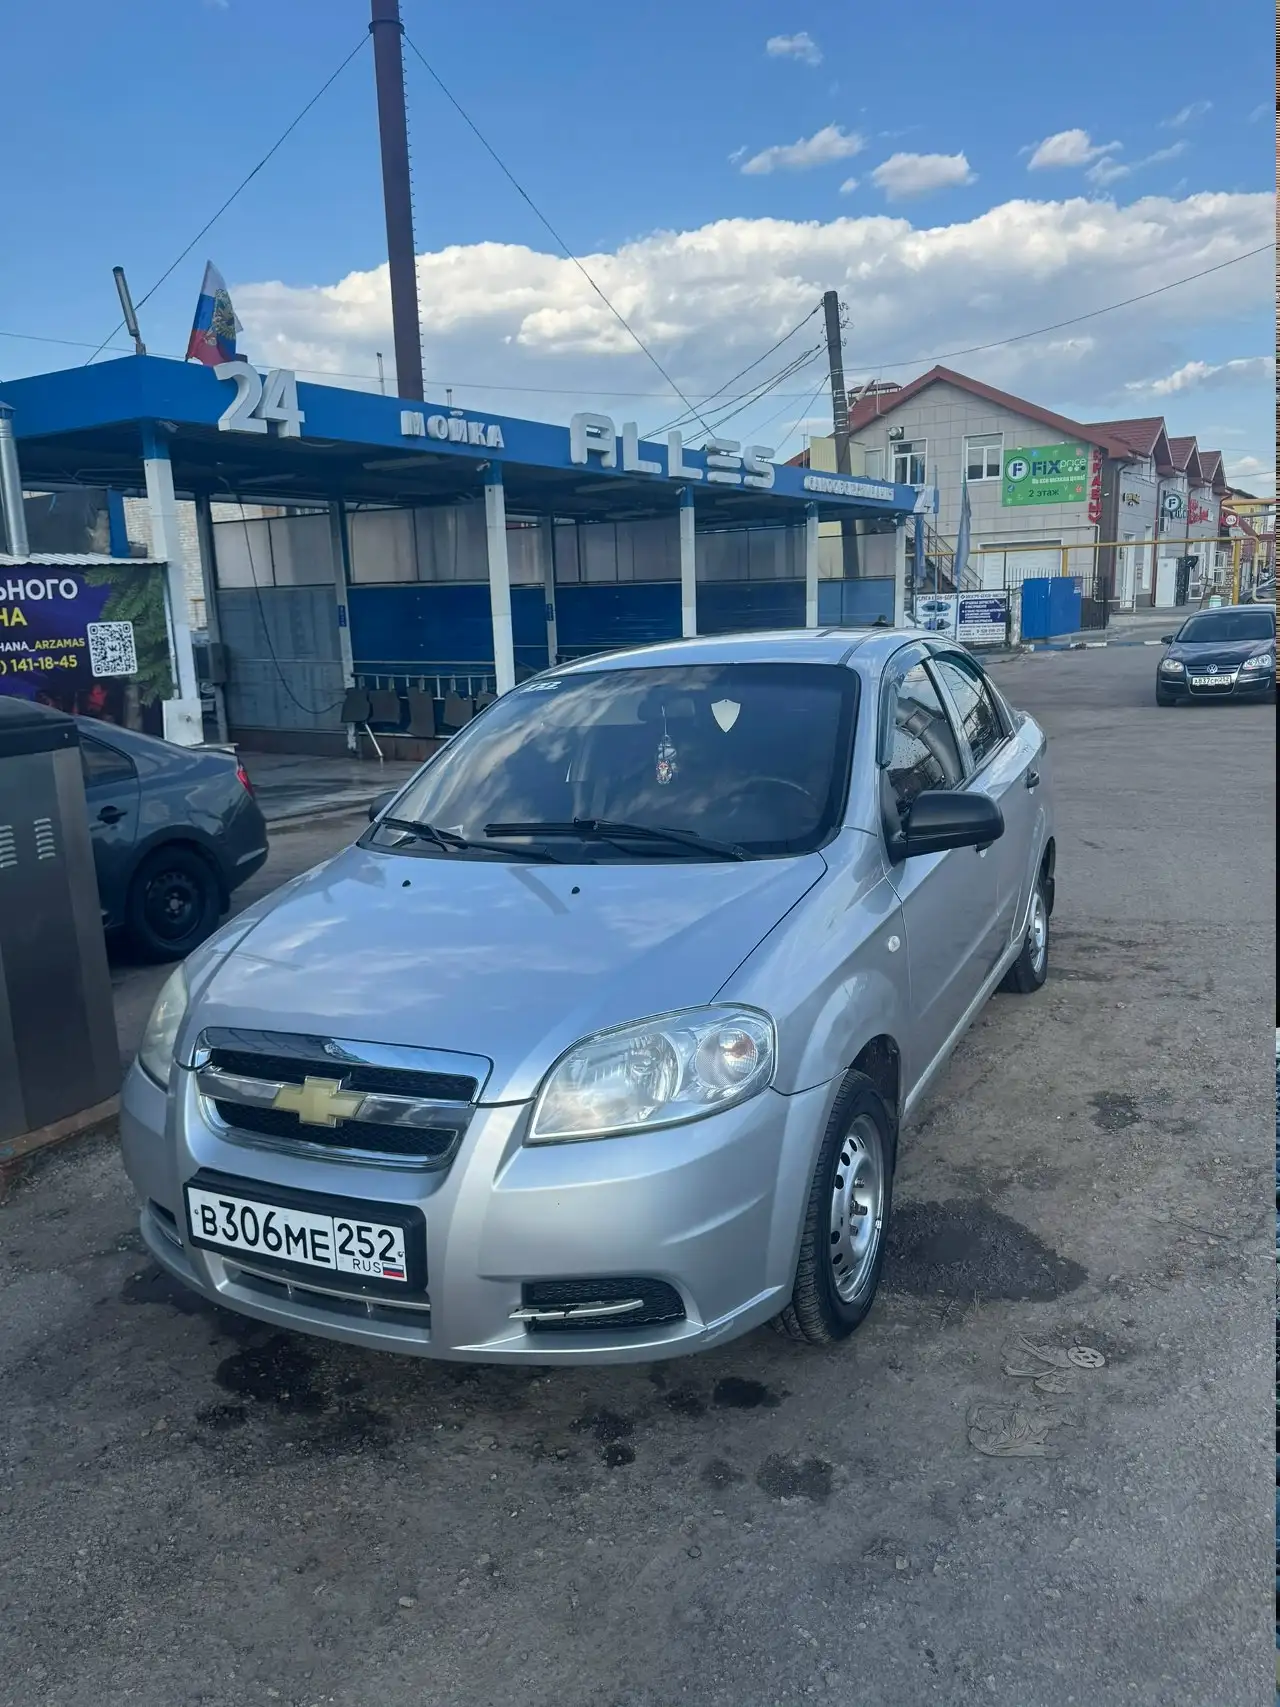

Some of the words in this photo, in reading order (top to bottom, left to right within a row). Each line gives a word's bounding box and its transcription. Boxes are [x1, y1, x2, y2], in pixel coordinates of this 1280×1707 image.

[213, 360, 305, 438] 24
[400, 409, 505, 448] МОЙКА
[570, 412, 775, 489] ALLES
[1028, 489, 1035, 498] 2
[1036, 488, 1060, 497] этаж
[11, 655, 78, 673] 141-18-45
[200, 1200, 331, 1264] В306МЕ
[337, 1222, 397, 1263] 252
[352, 1258, 382, 1275] RUS
